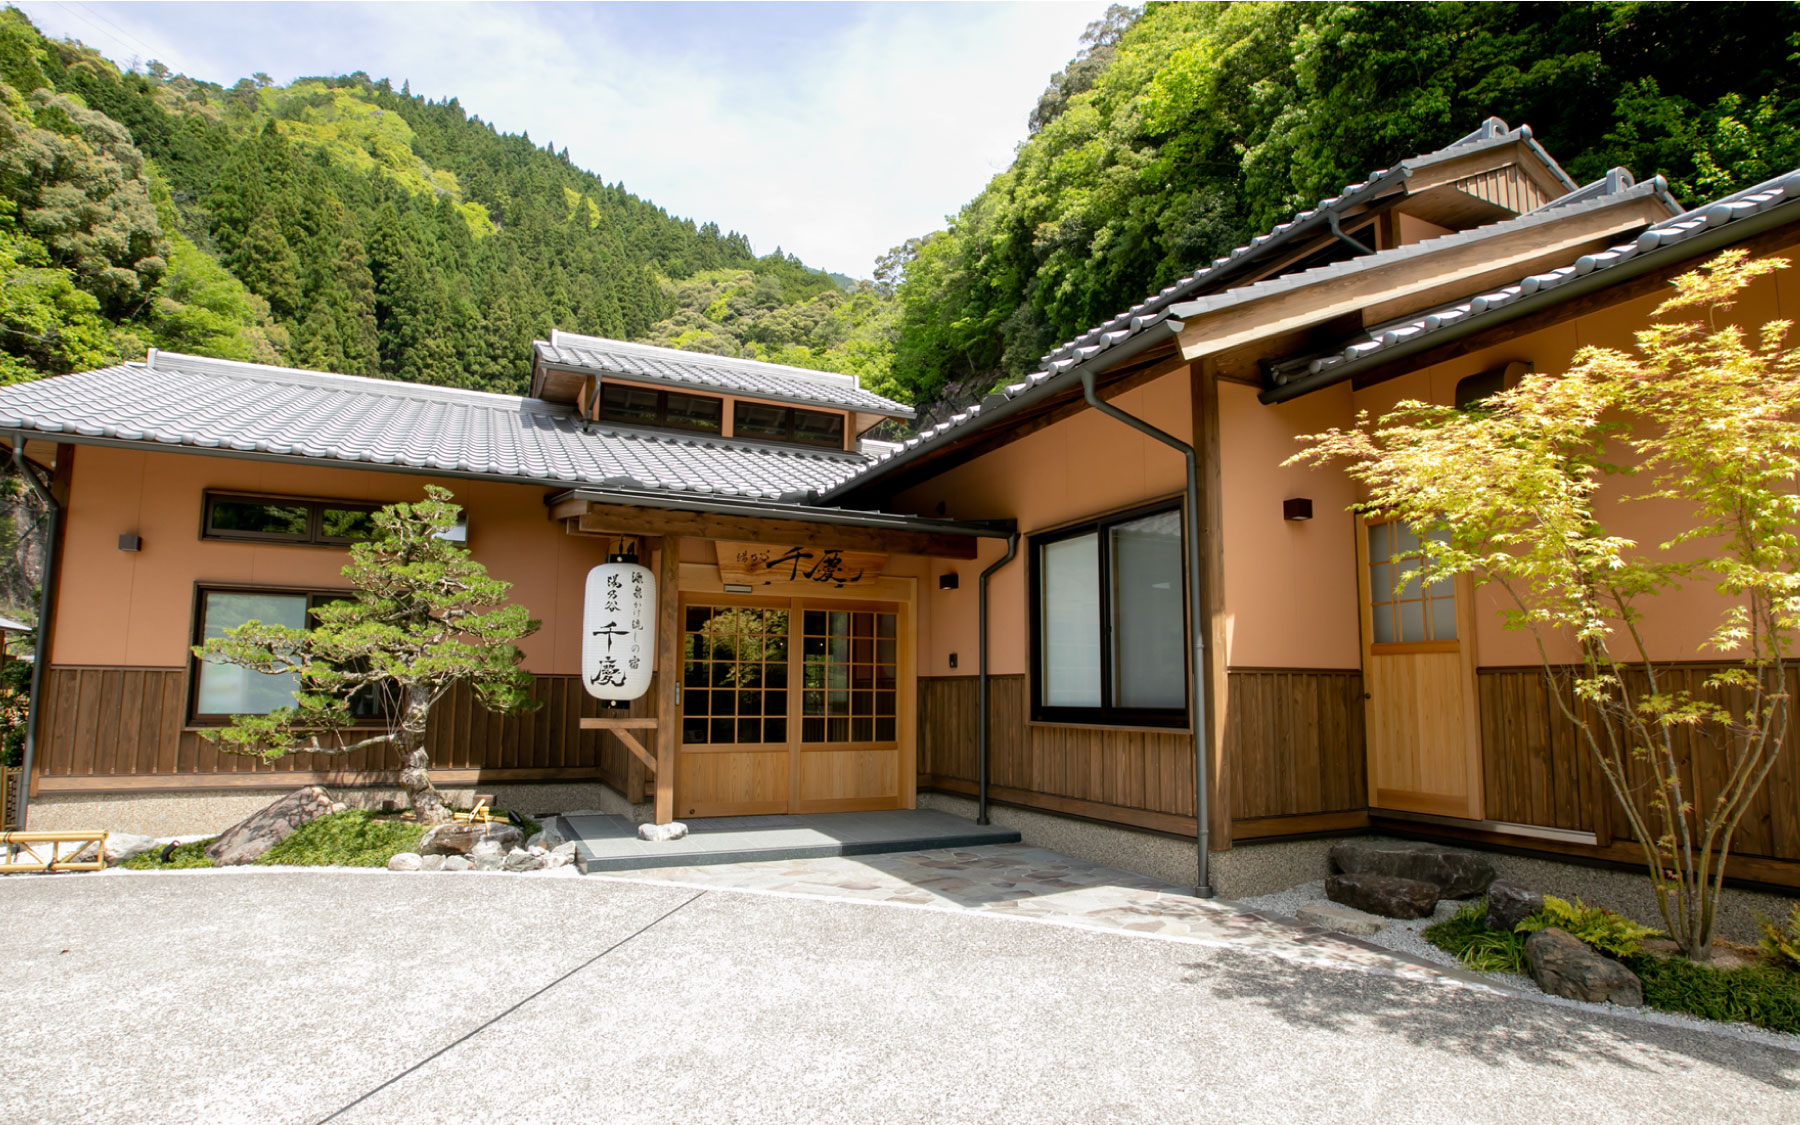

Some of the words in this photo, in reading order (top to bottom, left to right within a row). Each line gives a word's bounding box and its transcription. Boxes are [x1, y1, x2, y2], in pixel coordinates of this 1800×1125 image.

[766, 546, 865, 582] 千慶
[590, 620, 630, 687] 千慶
[628, 571, 644, 670] 源泉かけ流しの宿
